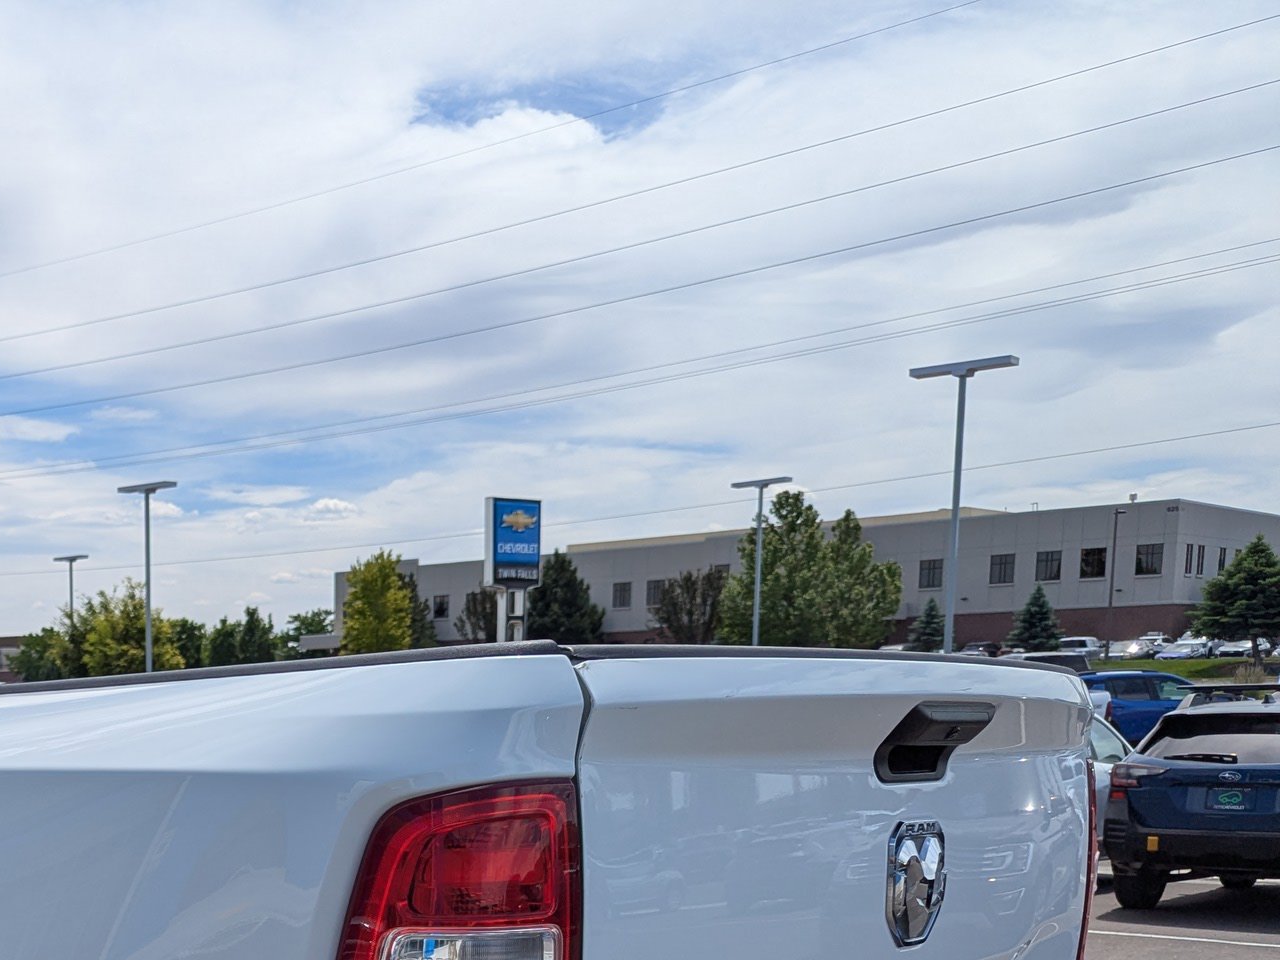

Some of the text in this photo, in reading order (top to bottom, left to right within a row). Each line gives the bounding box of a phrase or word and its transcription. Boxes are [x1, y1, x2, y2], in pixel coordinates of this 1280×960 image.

[497, 543, 538, 554] CHEVROLET
[498, 568, 538, 580] TWIN FALLS
[905, 822, 936, 834] RAM
